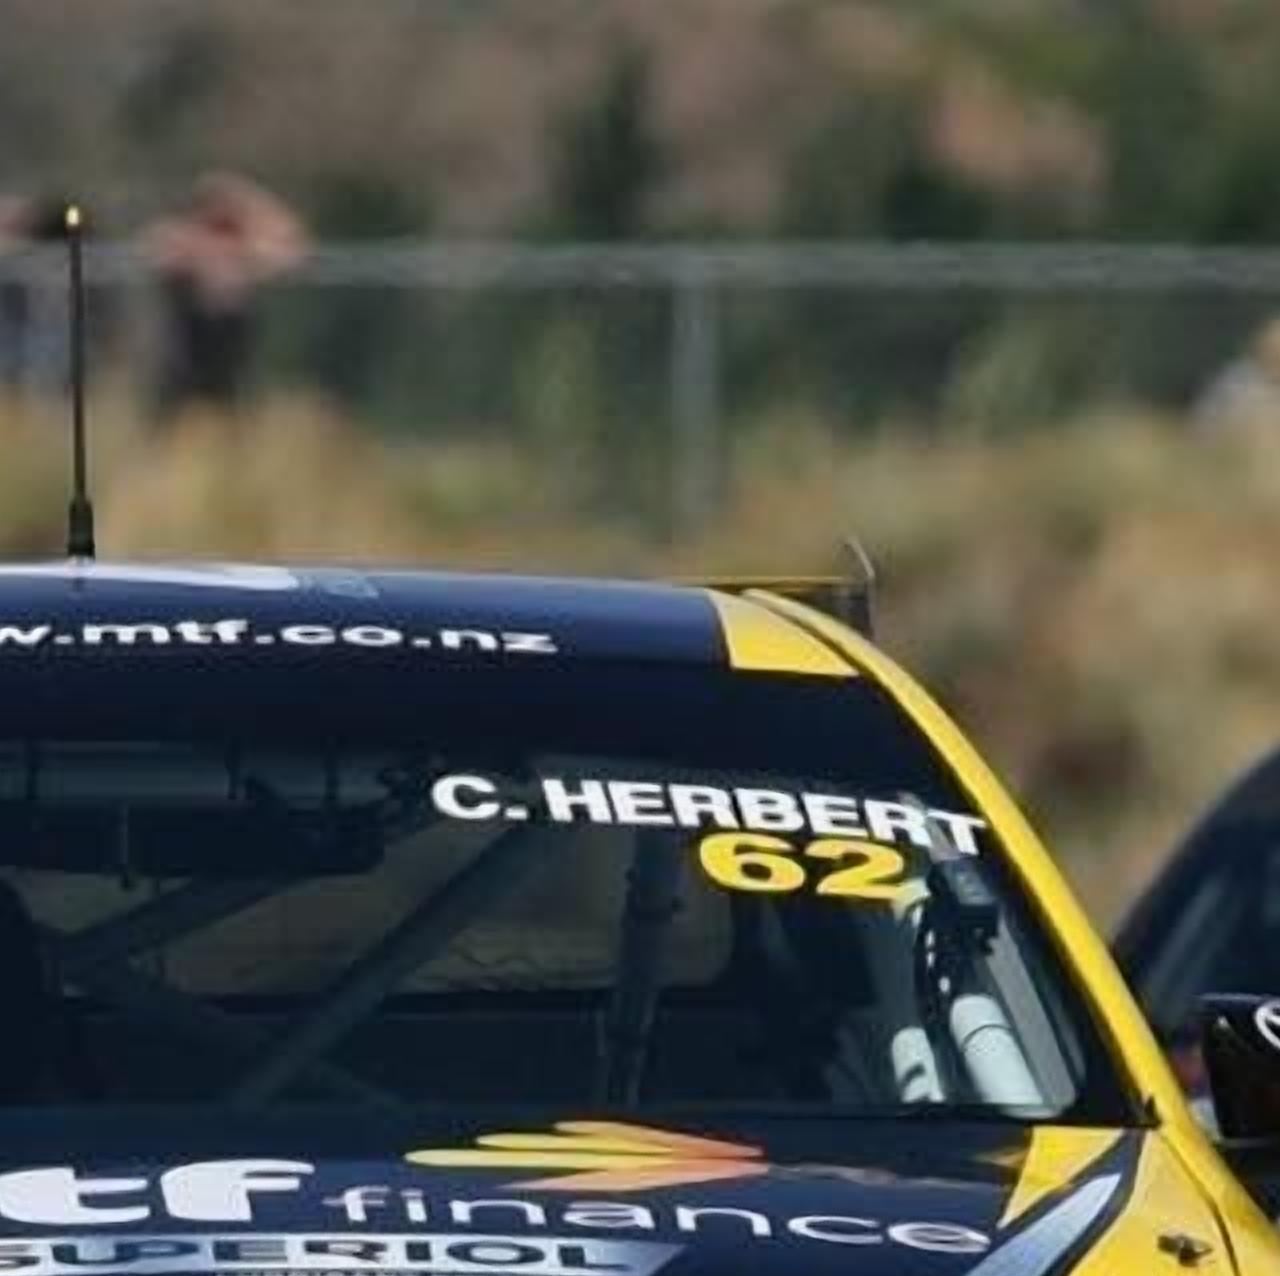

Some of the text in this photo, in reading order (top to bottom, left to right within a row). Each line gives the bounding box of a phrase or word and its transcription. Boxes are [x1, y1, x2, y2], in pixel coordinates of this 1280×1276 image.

[430, 773, 988, 856] C. HERBERT
[697, 831, 928, 899] 62
[321, 1185, 993, 1254] finance
